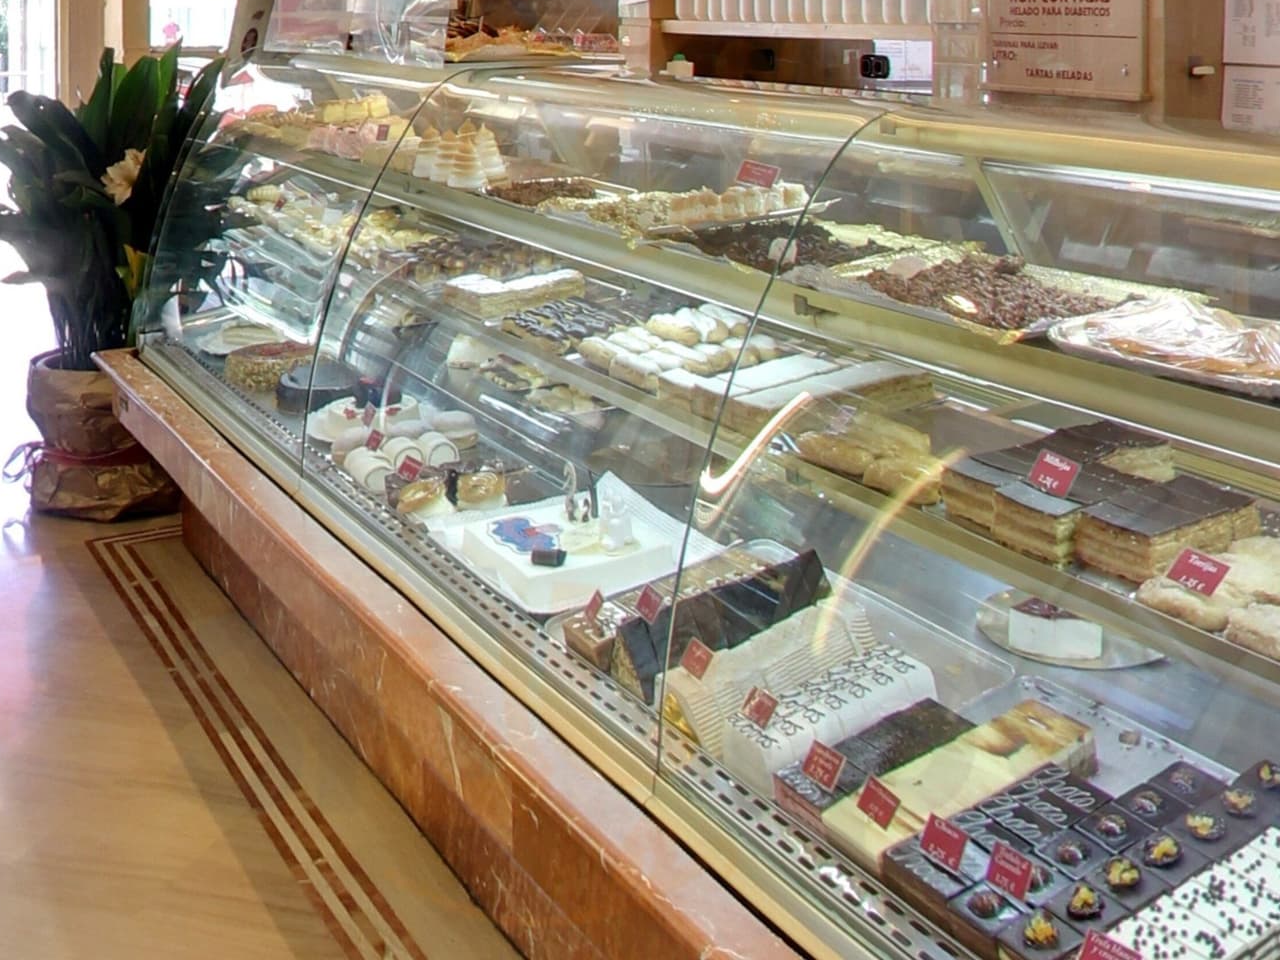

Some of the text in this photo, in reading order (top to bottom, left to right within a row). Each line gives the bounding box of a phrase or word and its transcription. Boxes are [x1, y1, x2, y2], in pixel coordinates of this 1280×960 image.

[1009, 6, 1111, 17] HELADO PARA DIABETICOS
[1025, 68, 1093, 81] TARTAS HELADAS
